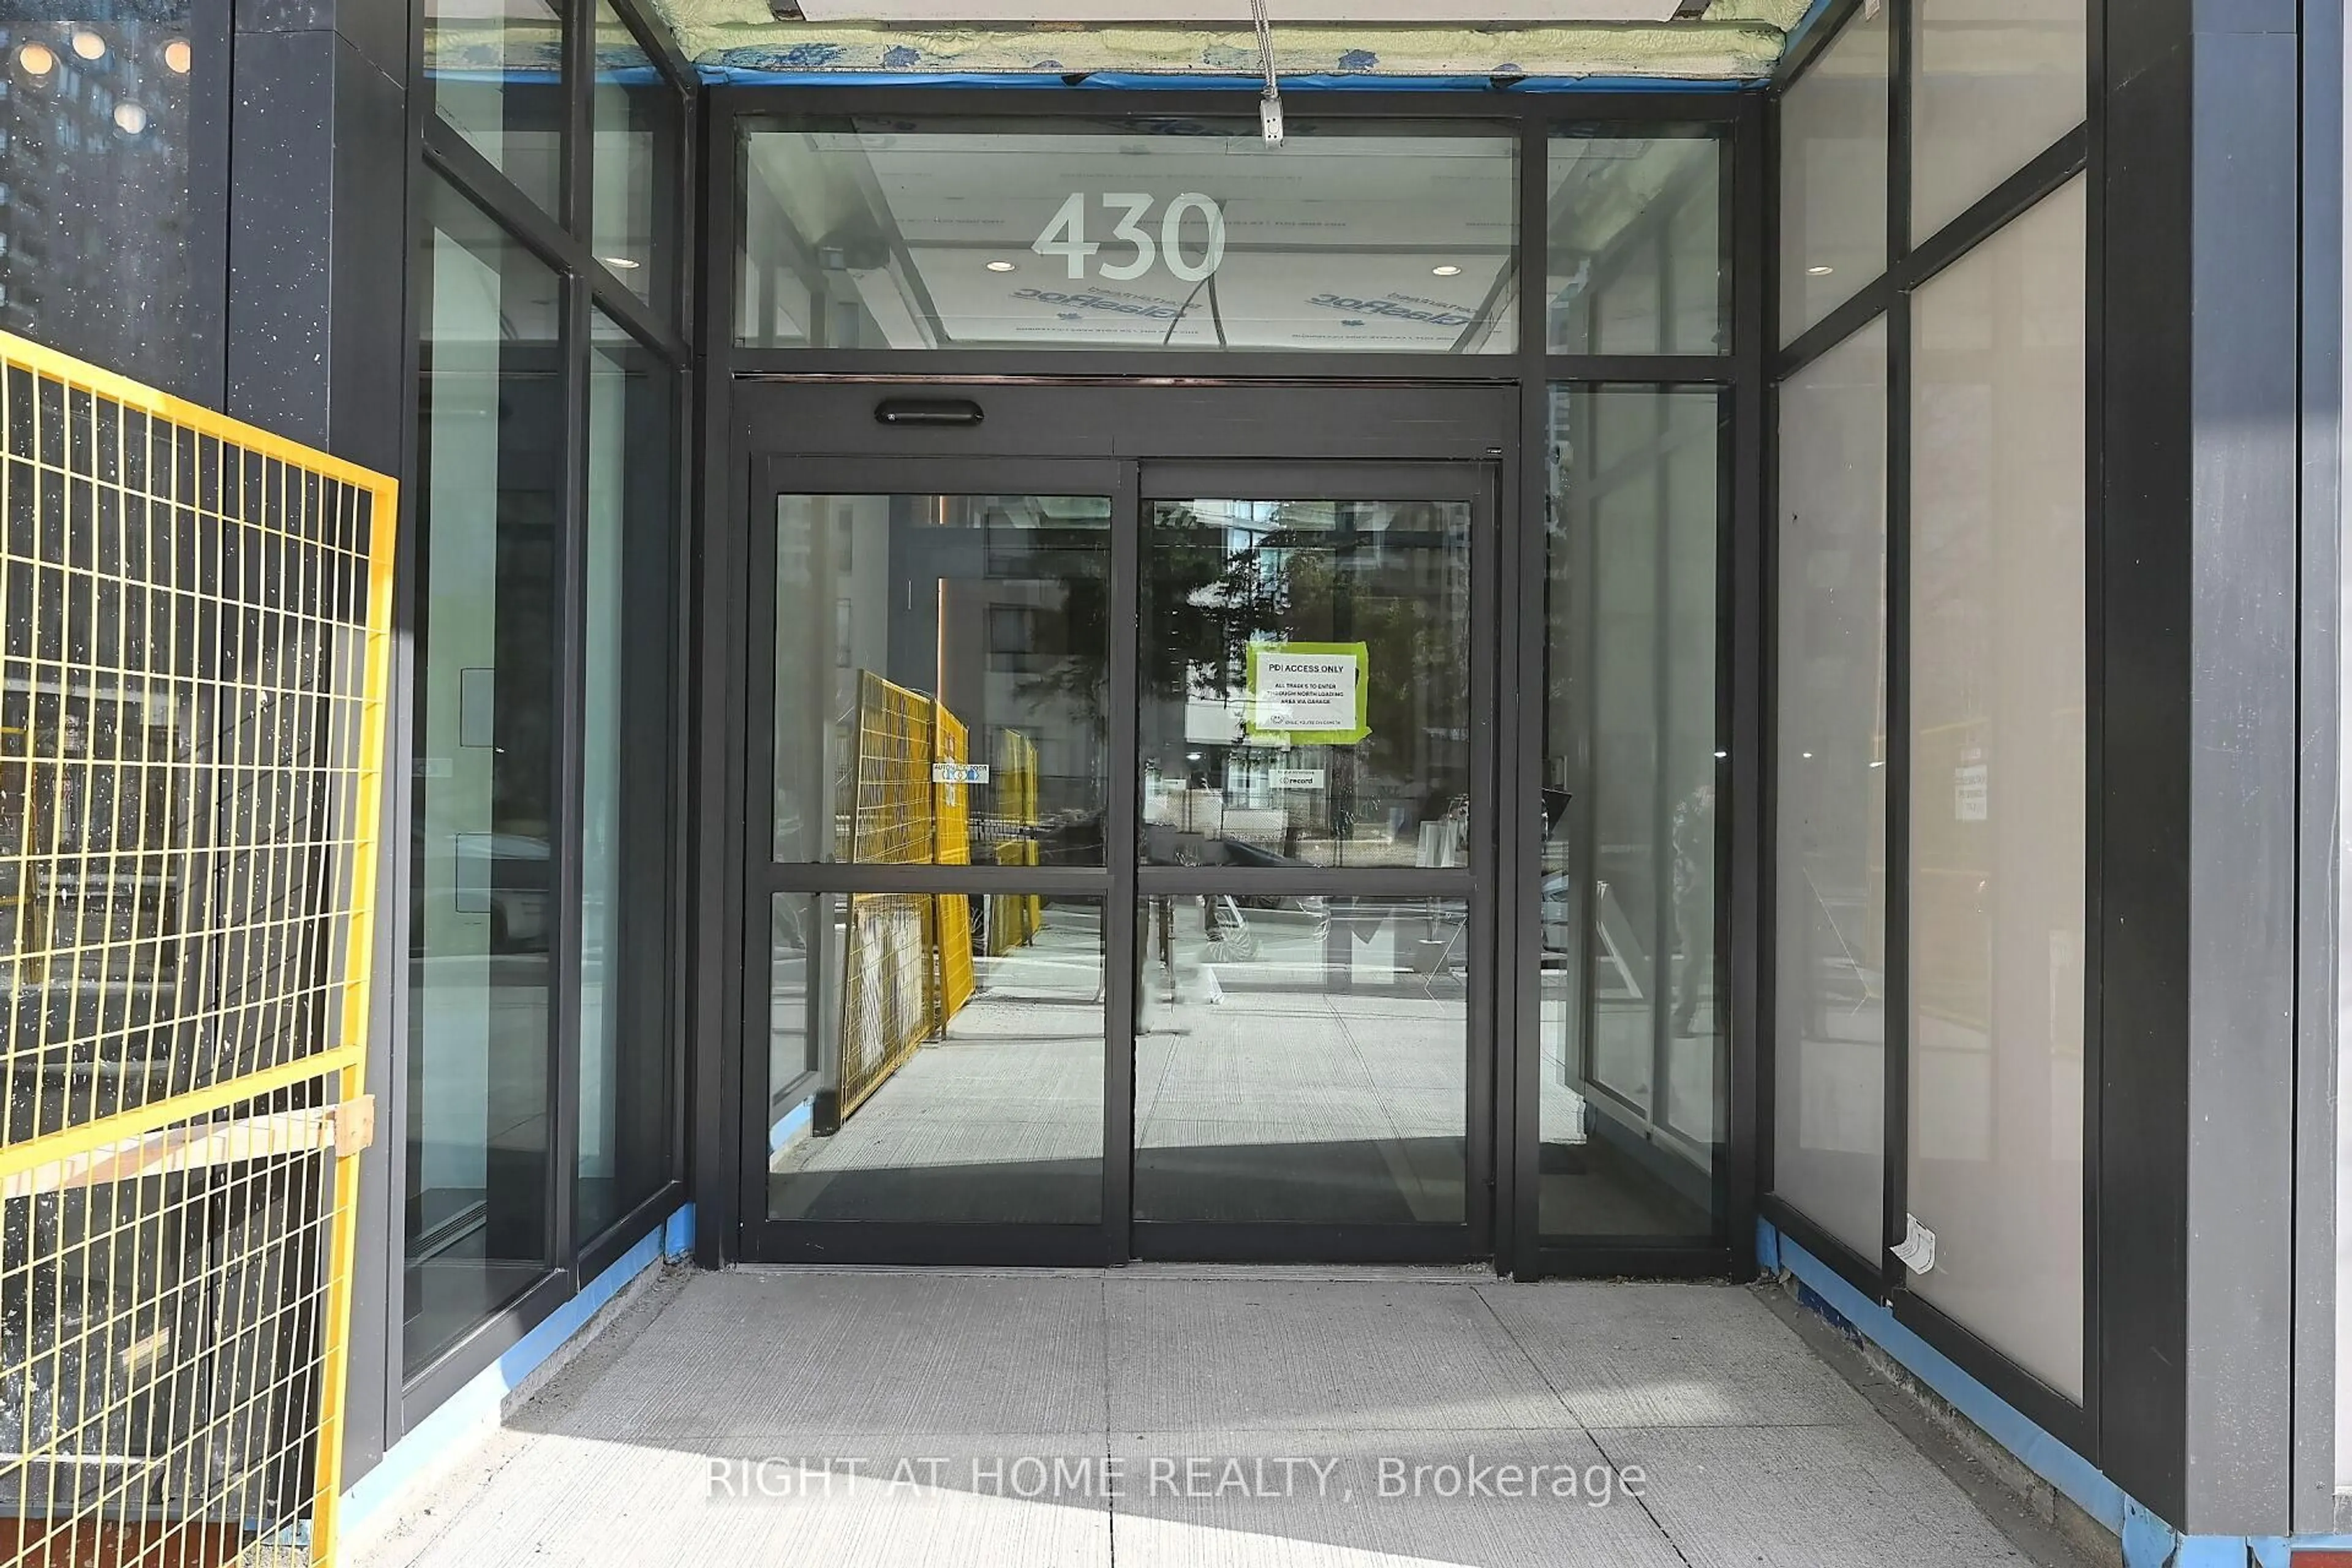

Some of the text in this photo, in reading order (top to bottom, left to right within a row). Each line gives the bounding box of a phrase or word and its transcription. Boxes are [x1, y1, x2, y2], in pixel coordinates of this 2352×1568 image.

[1031, 192, 1226, 282] 430
[1269, 663, 1283, 672] PDI
[1285, 665, 1319, 673] ACCESS
